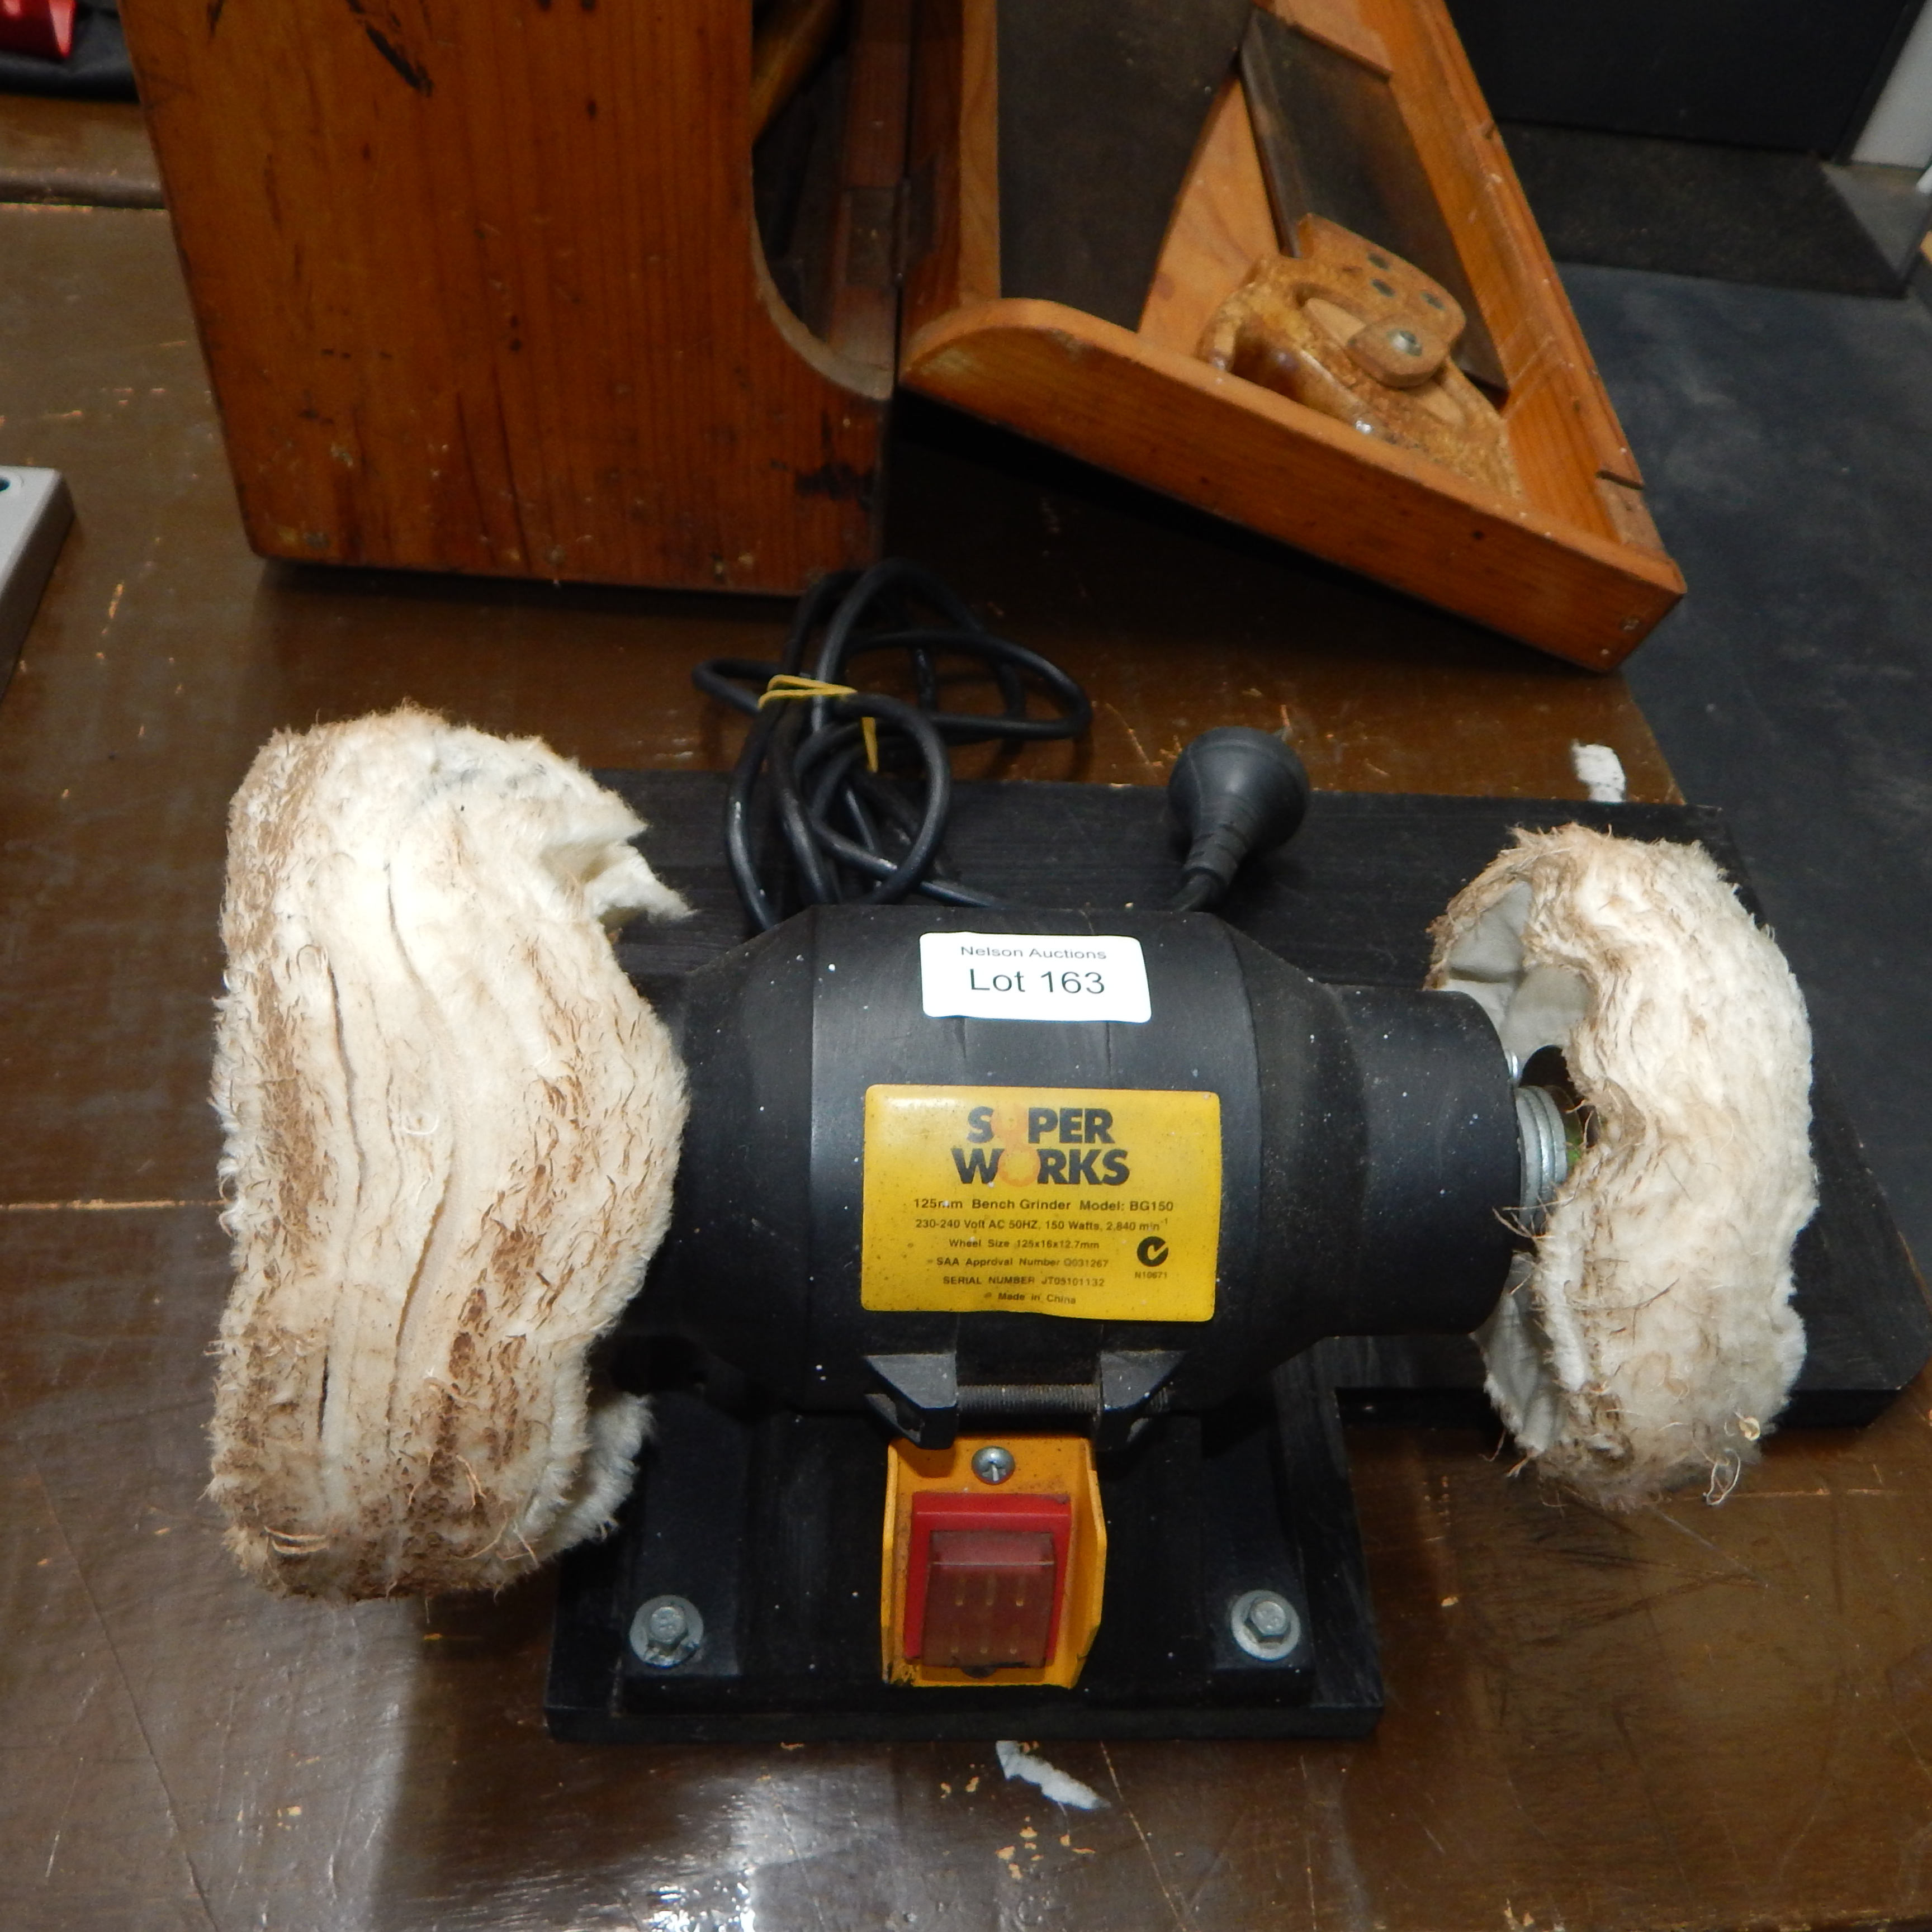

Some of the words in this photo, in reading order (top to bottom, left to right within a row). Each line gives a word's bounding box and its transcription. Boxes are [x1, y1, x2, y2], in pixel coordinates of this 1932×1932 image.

[960, 946, 1023, 957] Nelson
[1029, 948, 1107, 959] Auctions
[969, 968, 1026, 992] Lot
[1040, 970, 1105, 994] 163
[914, 1199, 963, 1209] 125mm
[972, 1199, 1015, 1209] Bench
[1020, 1199, 1071, 1210] Grinder
[1079, 1200, 1125, 1211] Model:
[1130, 1201, 1173, 1211] BG150
[915, 1219, 960, 1229] 230-240
[964, 1220, 985, 1229] Volt
[988, 1220, 1005, 1229] AC
[1046, 1220, 1064, 1230] 150
[949, 1238, 982, 1248] Wheel
[987, 1239, 1010, 1248] Size
[936, 1257, 959, 1266] SAA
[965, 1258, 1013, 1267] Approval
[1019, 1258, 1060, 1267] Number
[943, 1276, 982, 1285] SERIAL
[988, 1276, 1035, 1285] NUMBER
[998, 1292, 1025, 1301] Made
[1046, 1294, 1076, 1304] China
